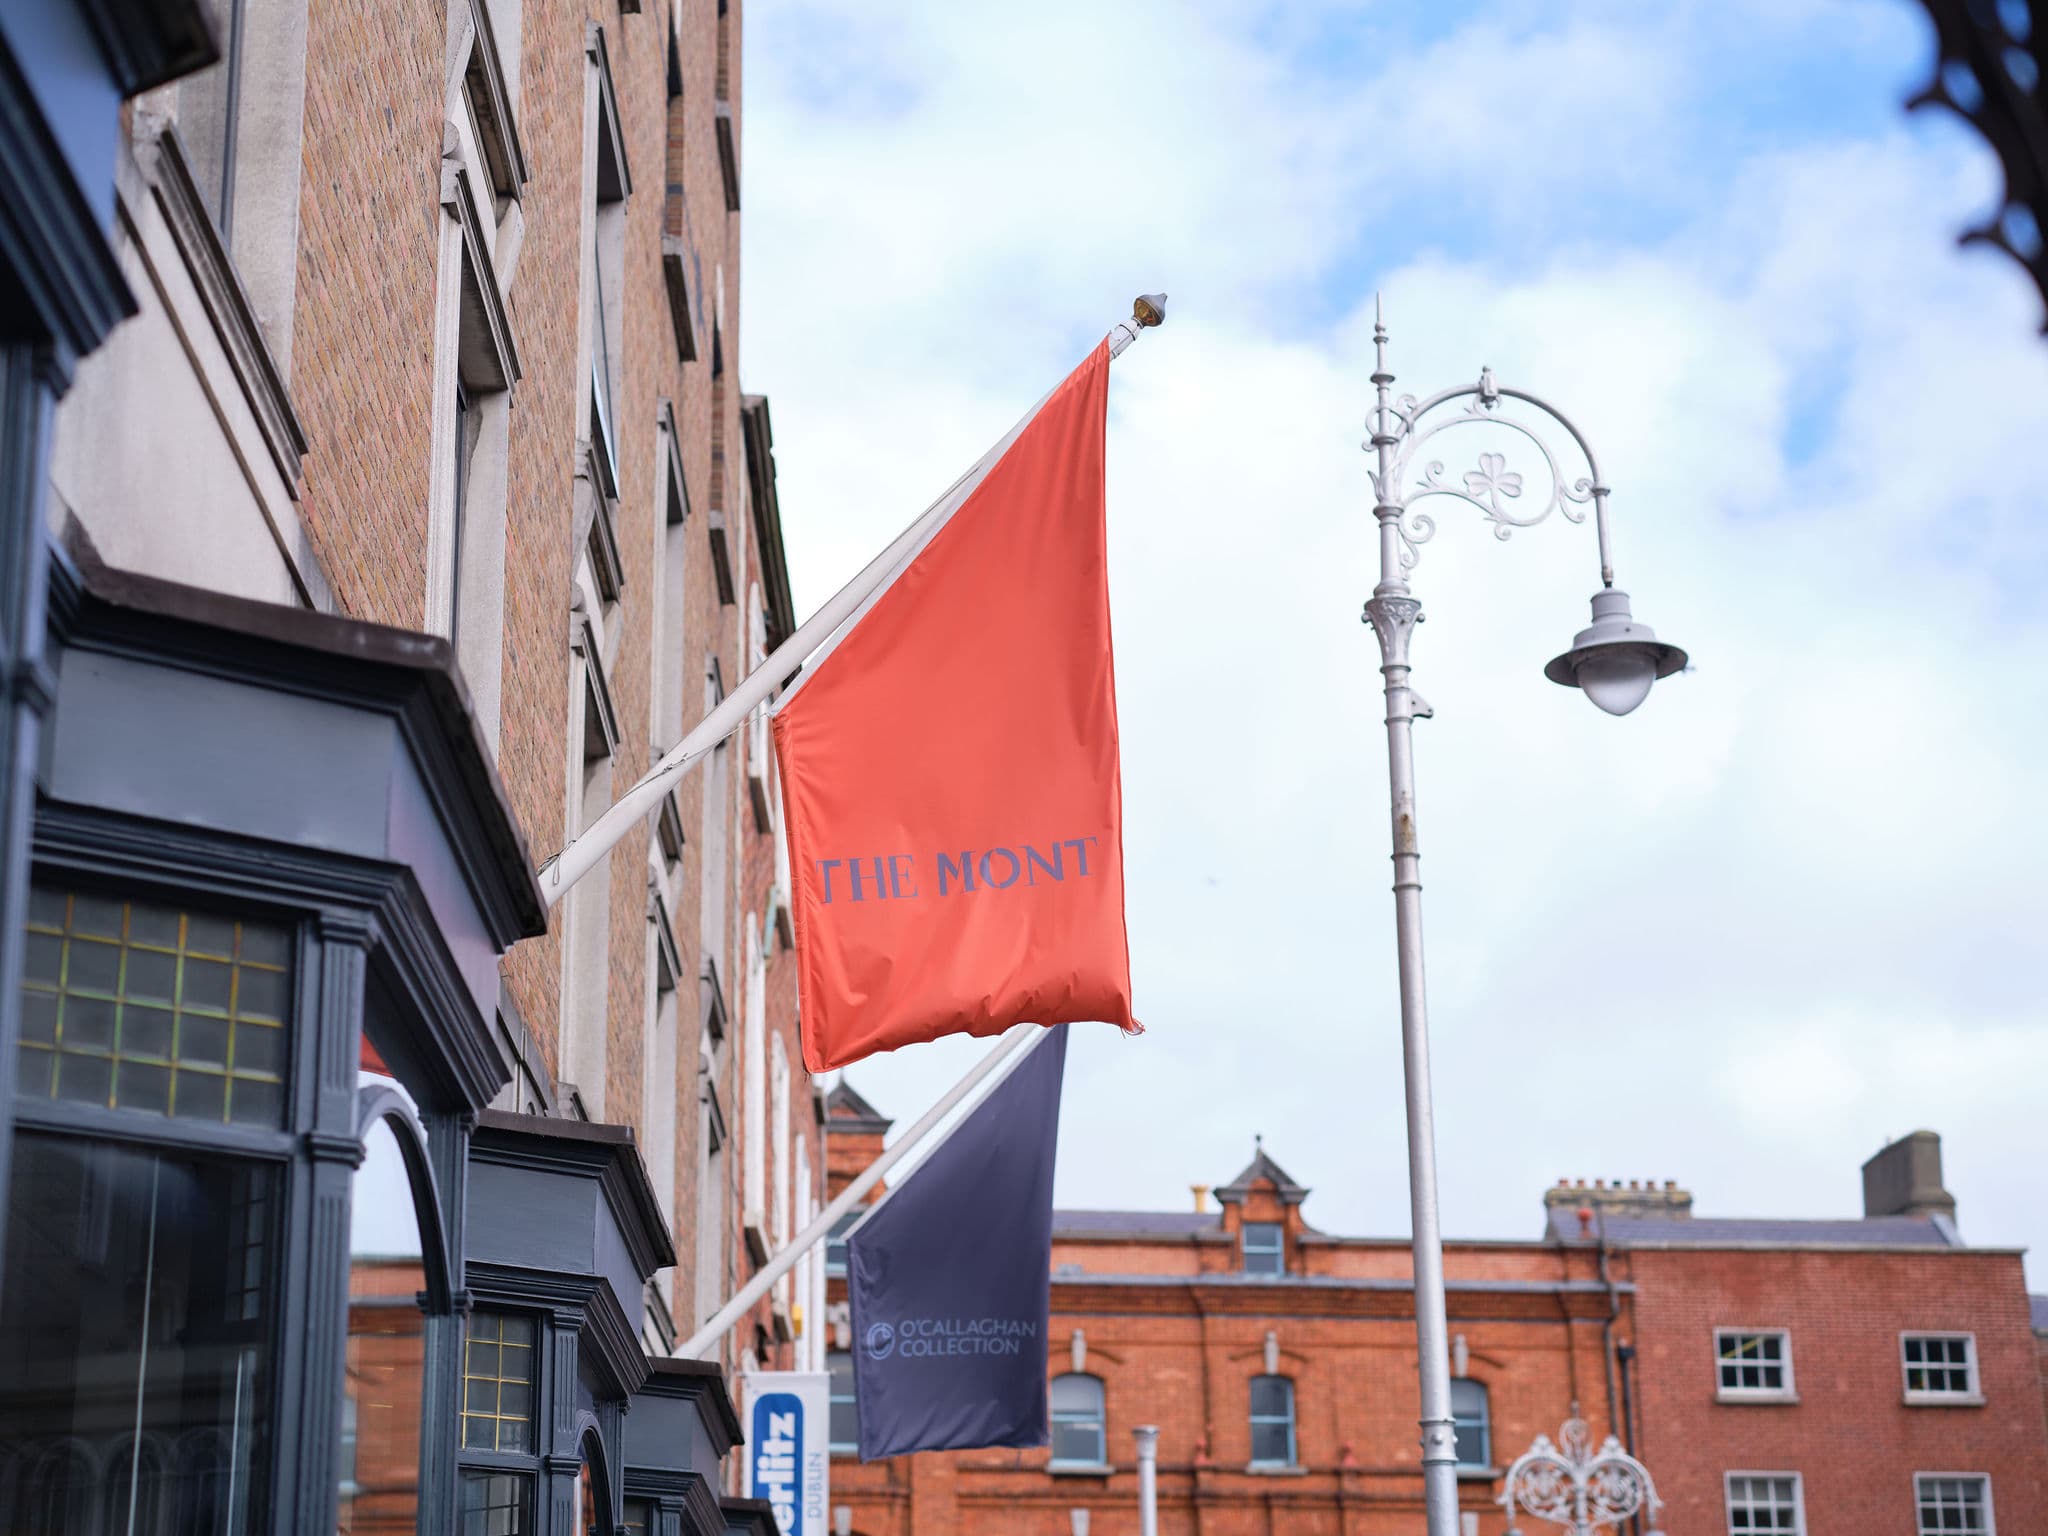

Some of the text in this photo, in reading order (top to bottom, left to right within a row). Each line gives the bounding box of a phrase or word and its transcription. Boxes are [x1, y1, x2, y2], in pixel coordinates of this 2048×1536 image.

[815, 836, 1098, 904] THE MONT
[899, 1319, 1037, 1338] O'CALLAGHAN
[899, 1337, 1020, 1358] COLLECTION
[757, 1411, 796, 1536] erlitz
[808, 1452, 823, 1520] DUBLIN
